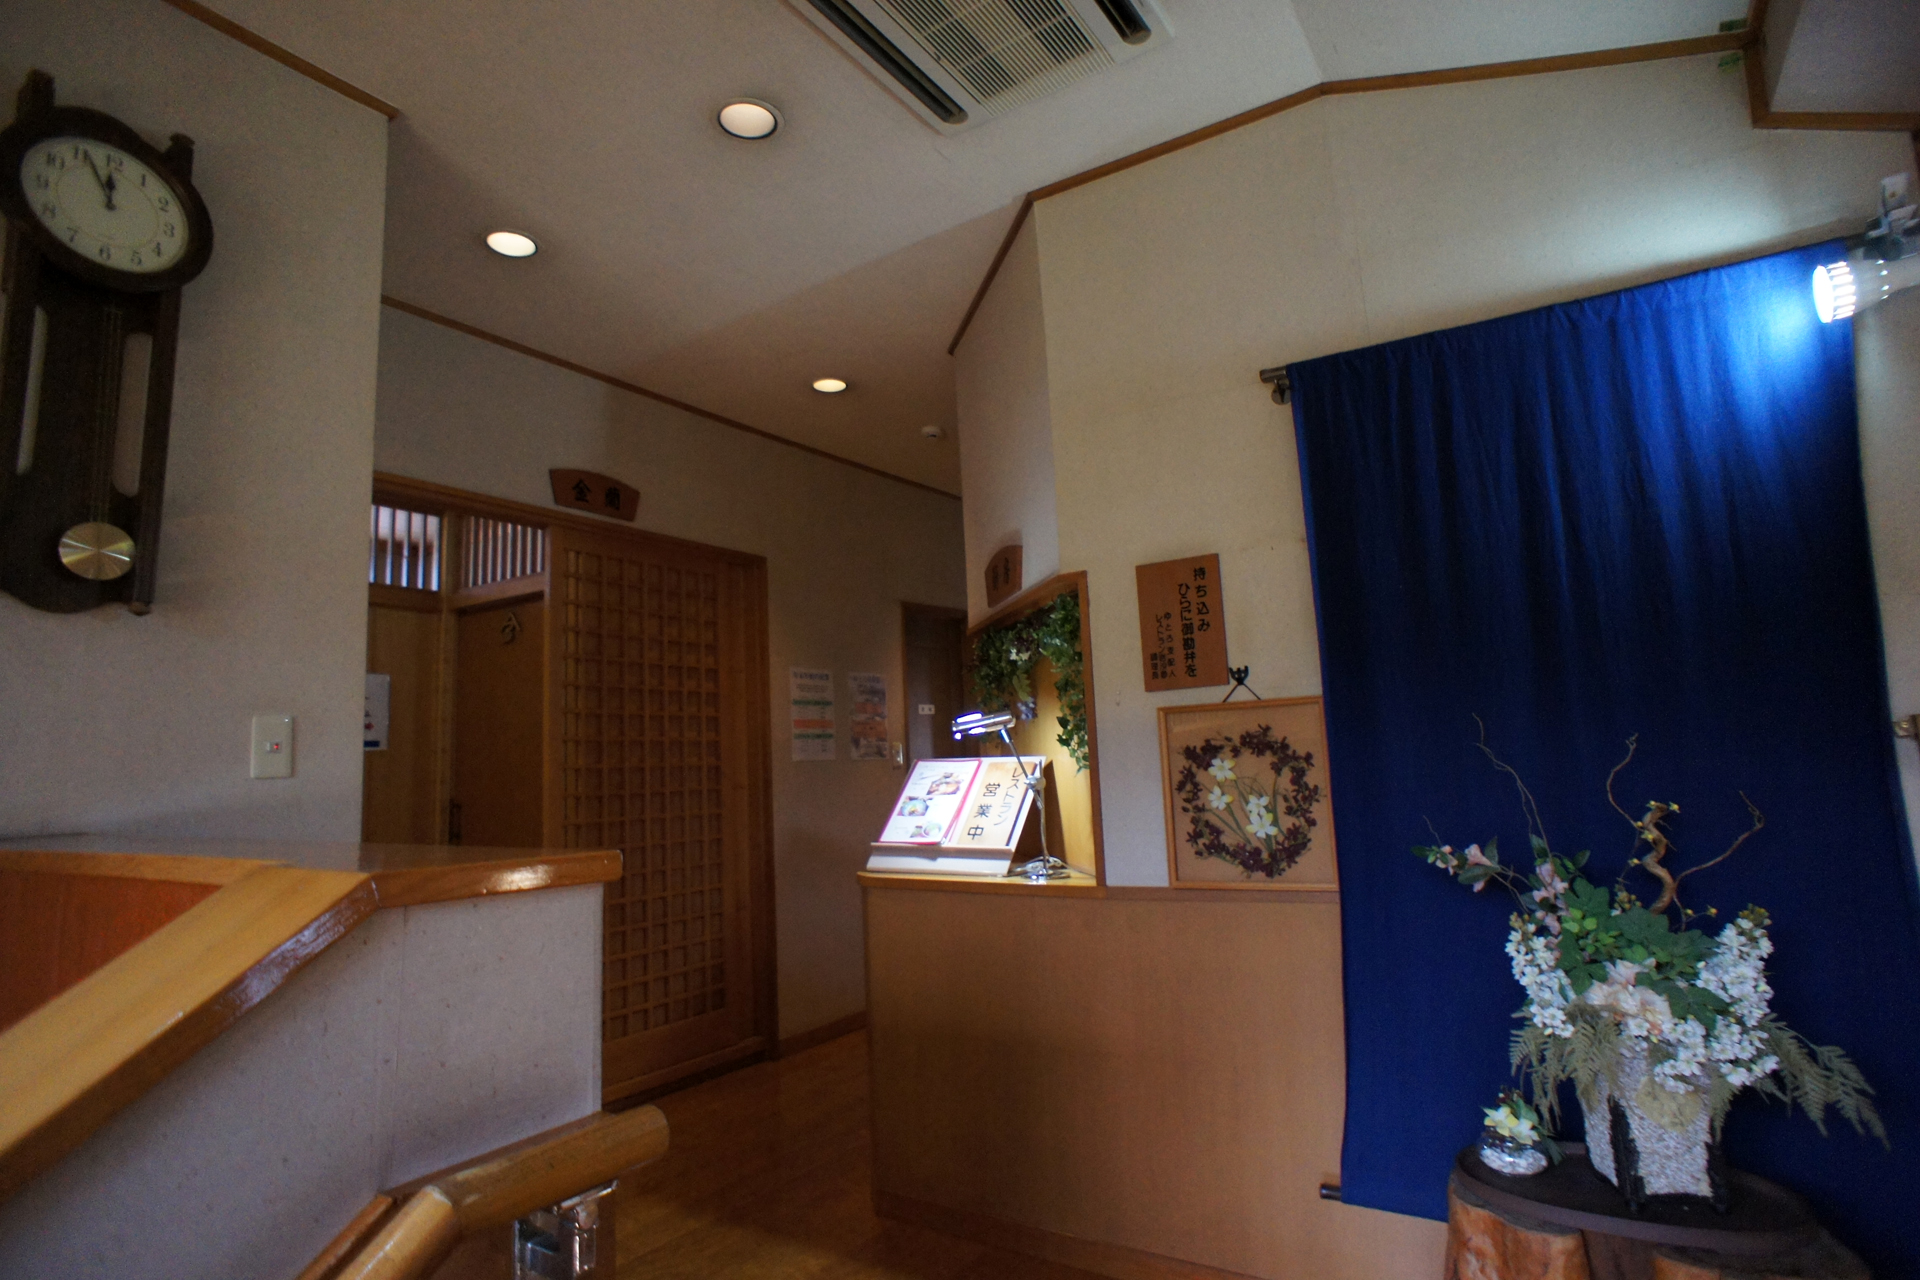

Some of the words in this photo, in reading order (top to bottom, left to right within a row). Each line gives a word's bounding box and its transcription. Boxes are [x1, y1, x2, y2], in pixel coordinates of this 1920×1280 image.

[46, 153, 65, 170] 10
[106, 153, 123, 173] 12
[36, 174, 49, 189] 9
[42, 202, 56, 219] 8
[158, 196, 169, 213] 2
[67, 227, 79, 242] 7
[164, 222, 175, 238] 3
[99, 244, 111, 260] 6
[153, 242, 162, 258] 4
[131, 252, 142, 266] 5
[1193, 566, 1210, 632] 持ち込み
[1177, 582, 1197, 678] ひらに御勘弁を
[1164, 612, 1177, 678] ゆとろ支配人
[993, 766, 1024, 826] レストラン
[967, 781, 1001, 840] 営業中
